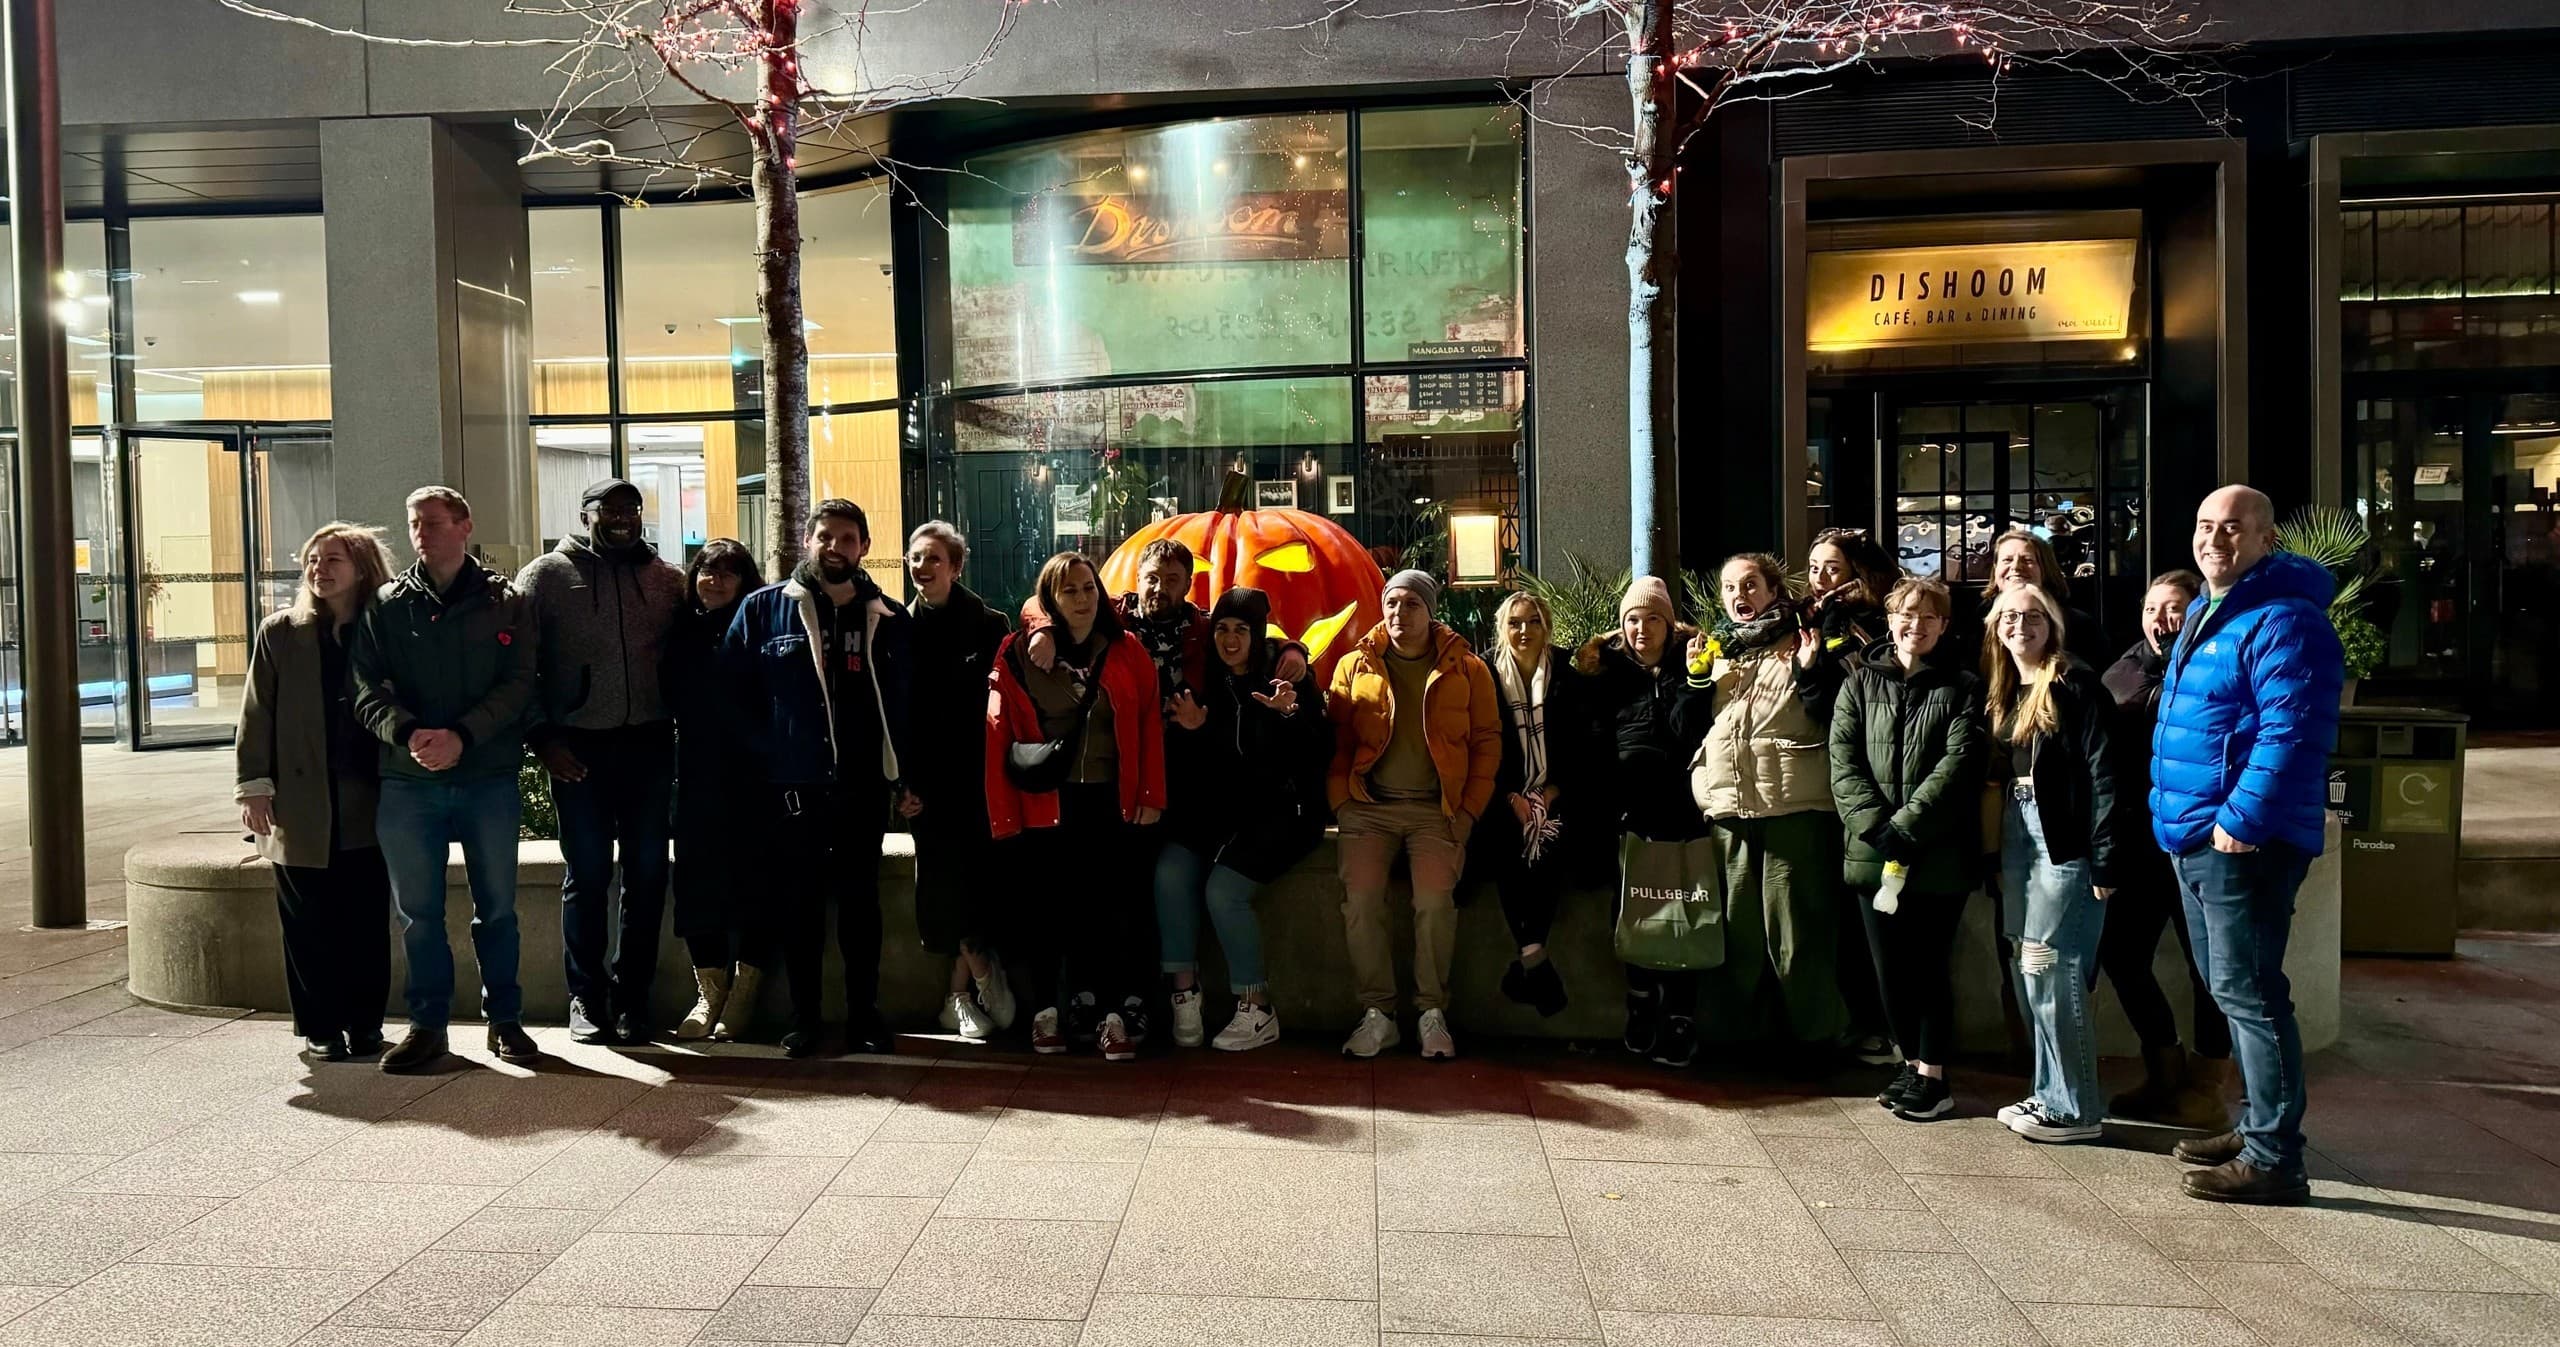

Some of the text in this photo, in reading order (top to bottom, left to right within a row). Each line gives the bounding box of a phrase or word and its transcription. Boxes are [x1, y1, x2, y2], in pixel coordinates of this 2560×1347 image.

[1870, 266, 2046, 302] DISHOOM
[1874, 306, 2037, 327] CAFÉ, BAR & DINING
[1413, 345, 1497, 355] MANGALDAS GULLY
[2353, 838, 2396, 850] Paradise
[1630, 886, 1710, 903] PULL&BEAR
